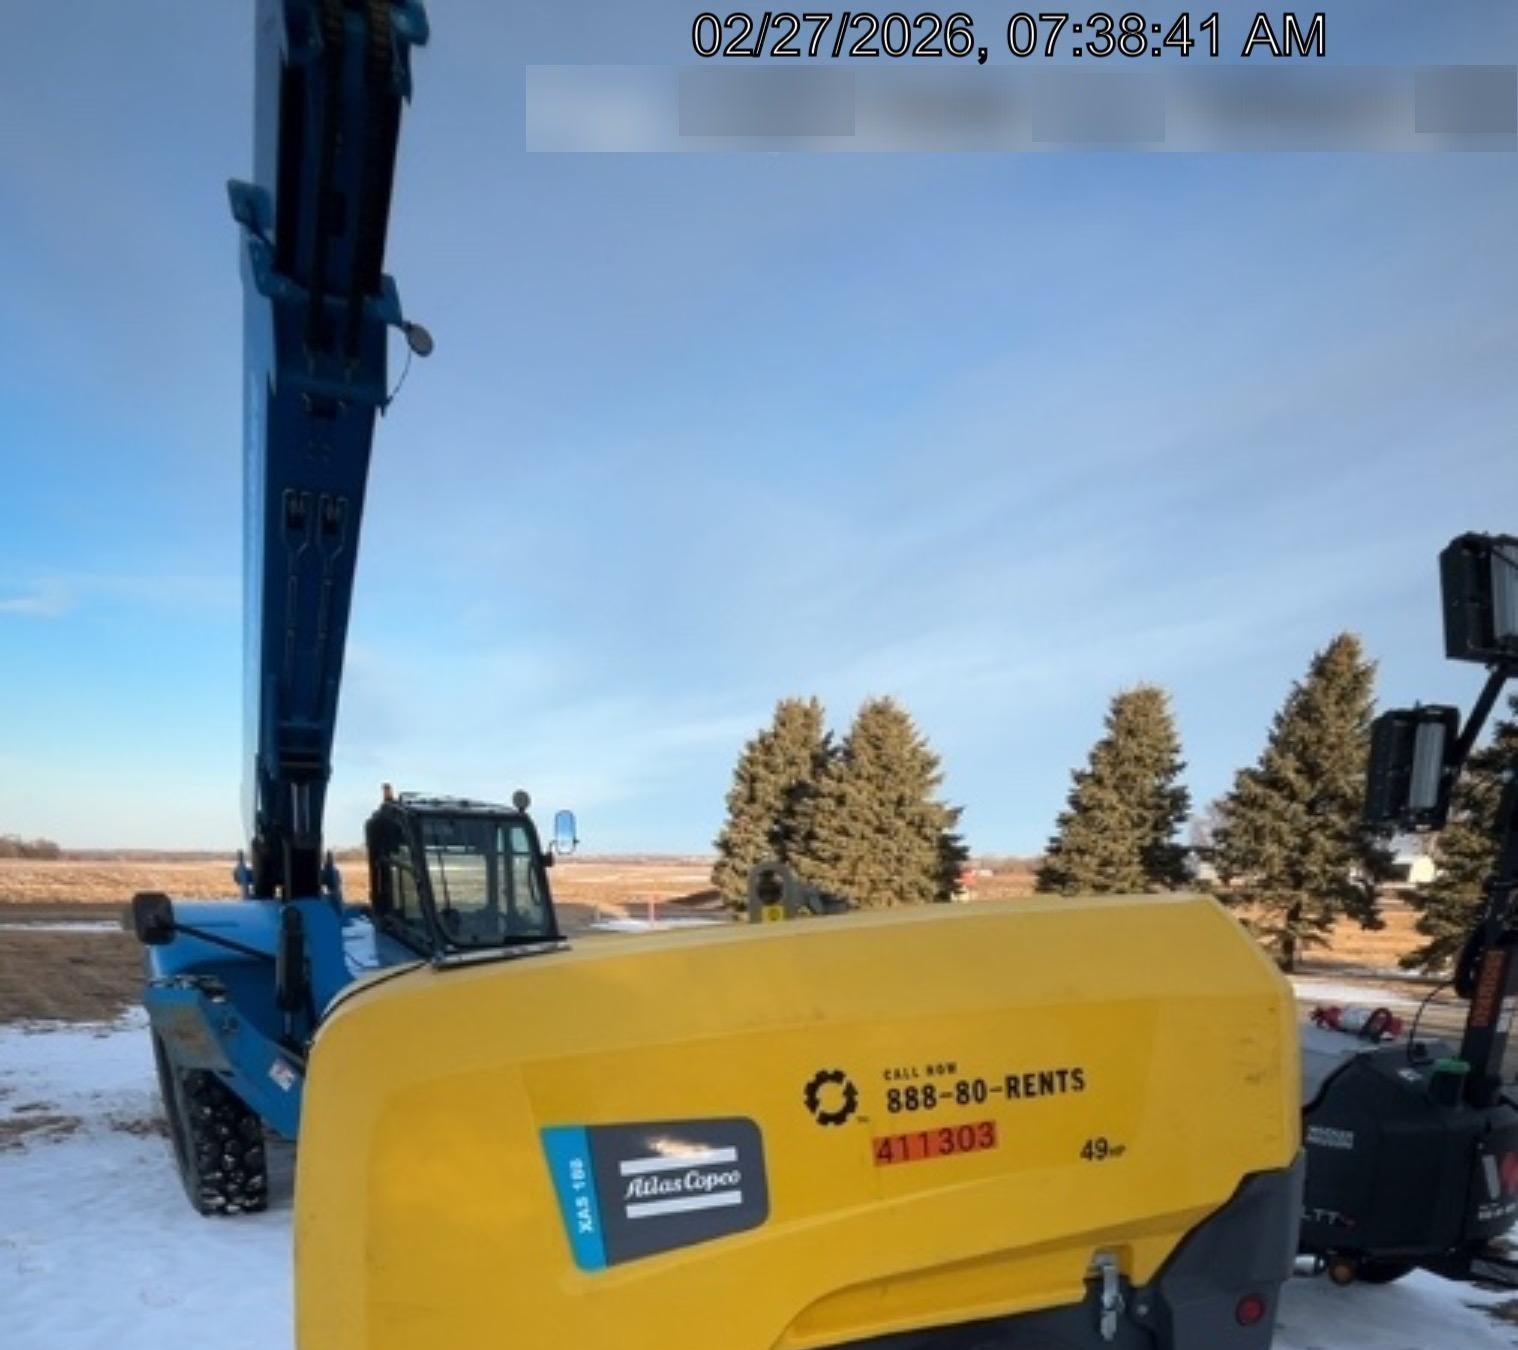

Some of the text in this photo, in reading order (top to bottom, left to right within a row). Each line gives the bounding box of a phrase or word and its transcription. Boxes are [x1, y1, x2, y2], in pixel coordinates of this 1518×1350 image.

[884, 1061, 958, 1080] CALL NOW
[886, 1068, 1086, 1113] 888-80-RENTS
[876, 1121, 995, 1164] 411303
[625, 1169, 741, 1200] Atlas Copco
[574, 1196, 594, 1233] XAS
